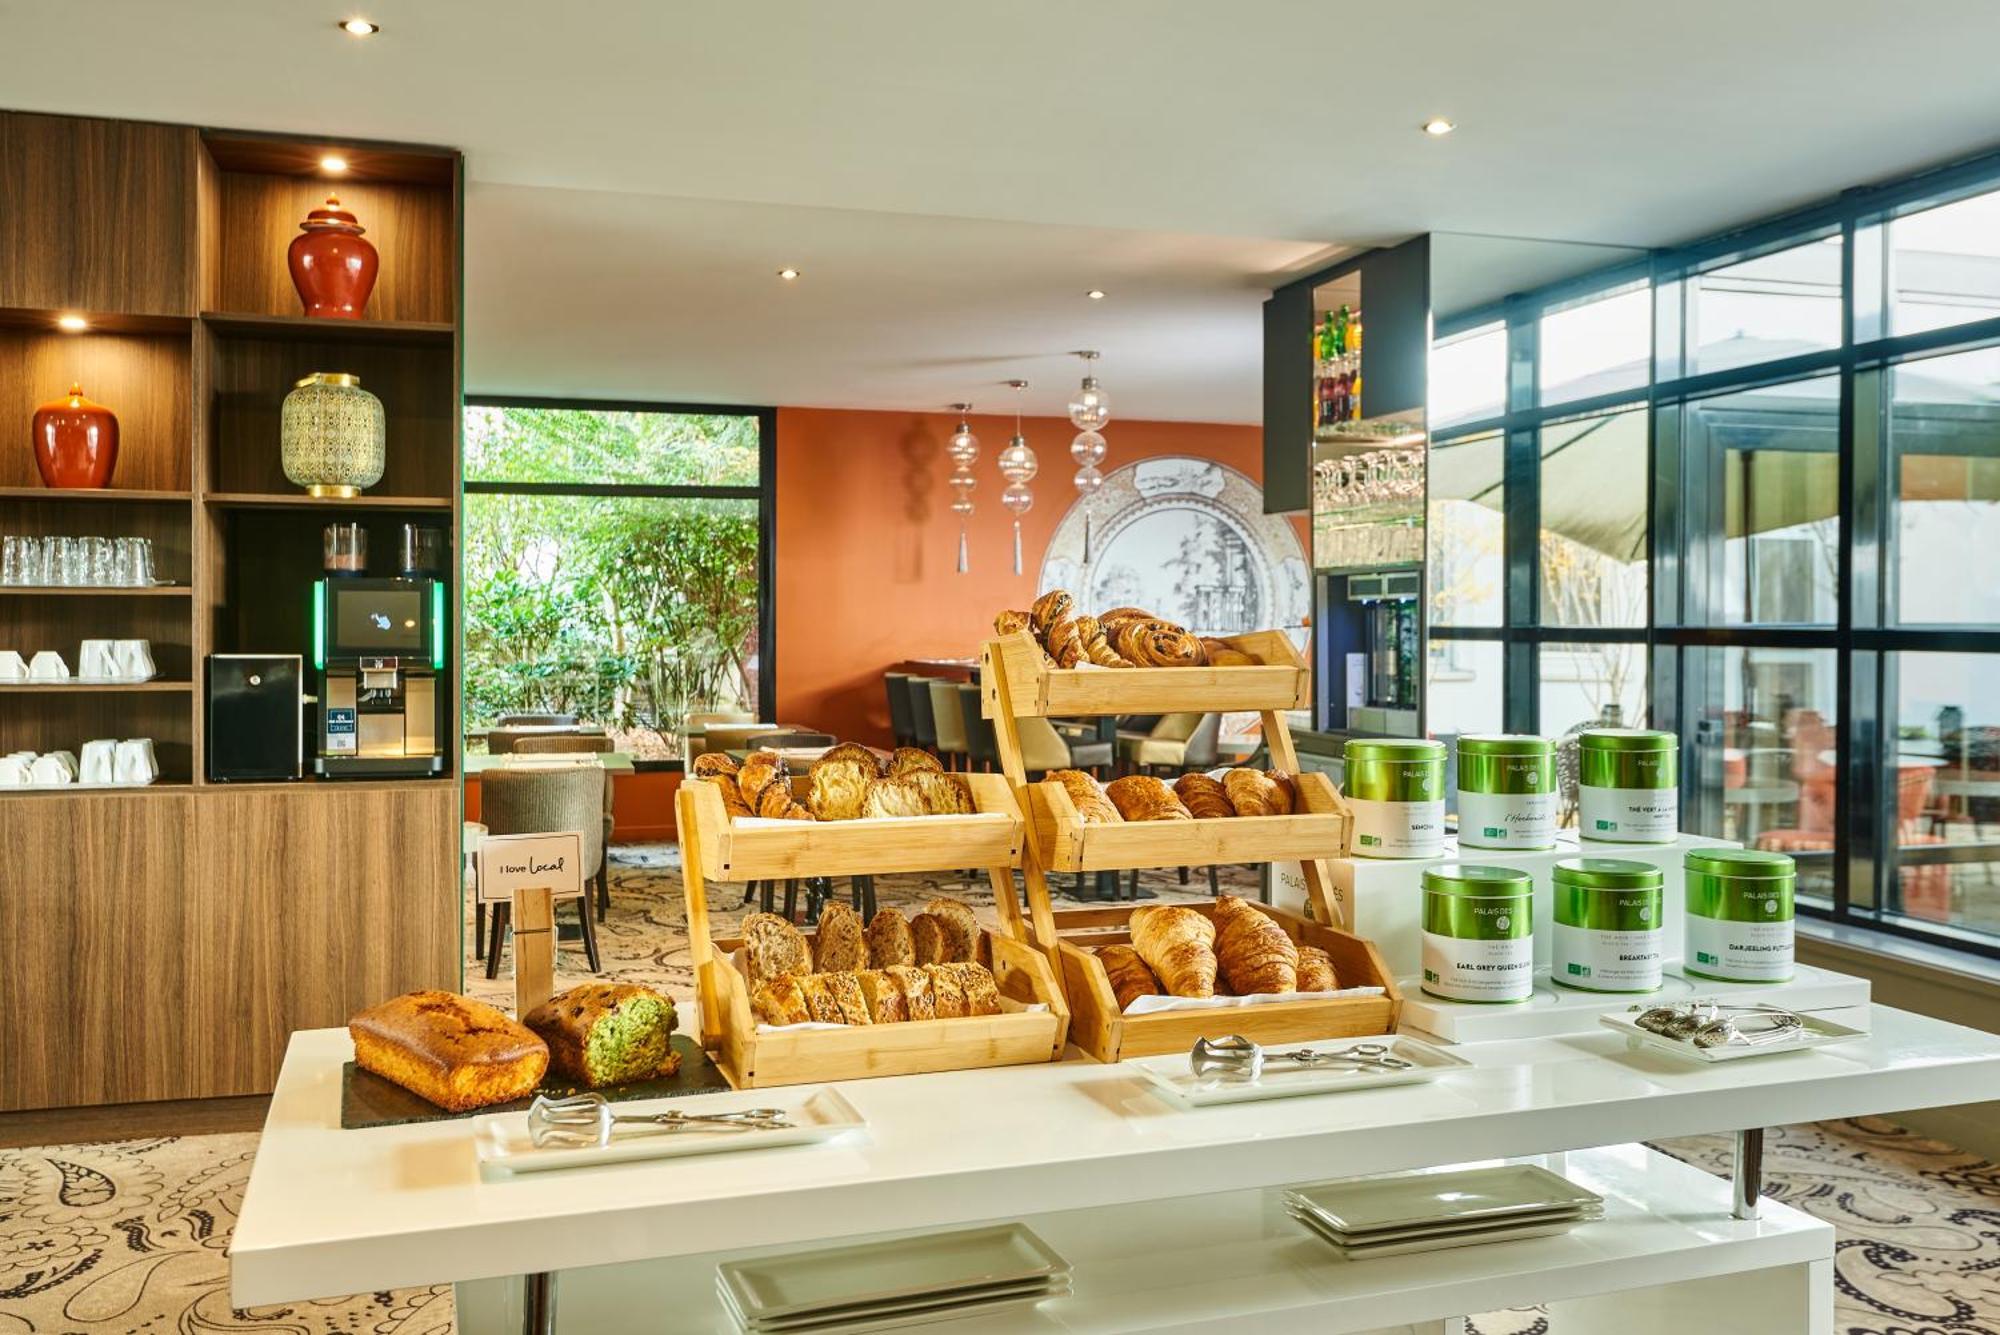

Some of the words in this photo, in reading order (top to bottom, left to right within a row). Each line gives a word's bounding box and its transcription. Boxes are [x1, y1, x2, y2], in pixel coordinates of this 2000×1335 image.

[506, 865, 526, 873] love
[1280, 872, 1306, 890] PALAIS
[1743, 891, 1767, 899] PALAIS
[1474, 907, 1499, 915] PALAIS
[1500, 907, 1513, 915] DES
[1728, 943, 1771, 952] DARJEELING
[1456, 962, 1475, 970] EARL
